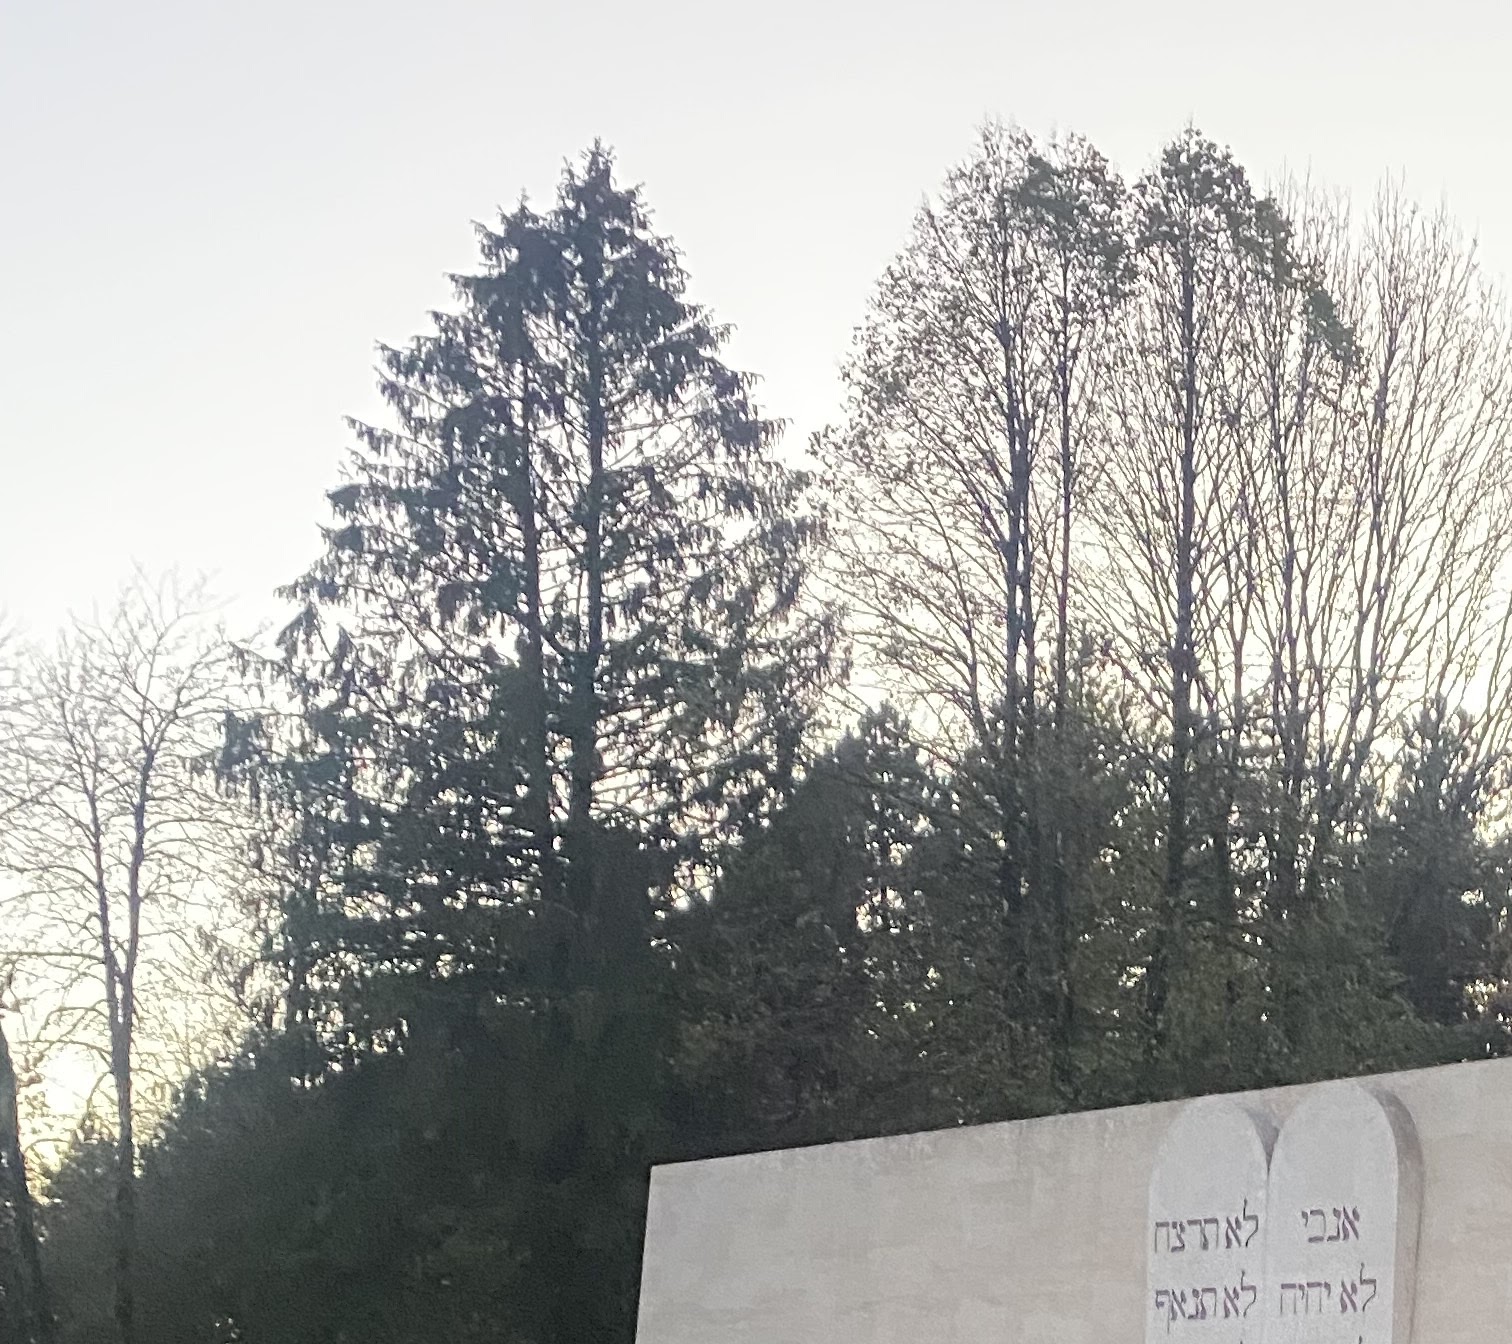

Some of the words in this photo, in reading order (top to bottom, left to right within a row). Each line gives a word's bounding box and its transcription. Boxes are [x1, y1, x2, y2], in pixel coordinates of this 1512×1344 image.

[1154, 1217, 1219, 1253] תרצח
[1224, 1198, 1259, 1249] לא
[1301, 1205, 1361, 1243] אנכי
[1155, 1287, 1217, 1334] תנאף
[1223, 1269, 1257, 1320] לא
[1280, 1281, 1332, 1315] יהיה
[1340, 1262, 1377, 1314] לא
